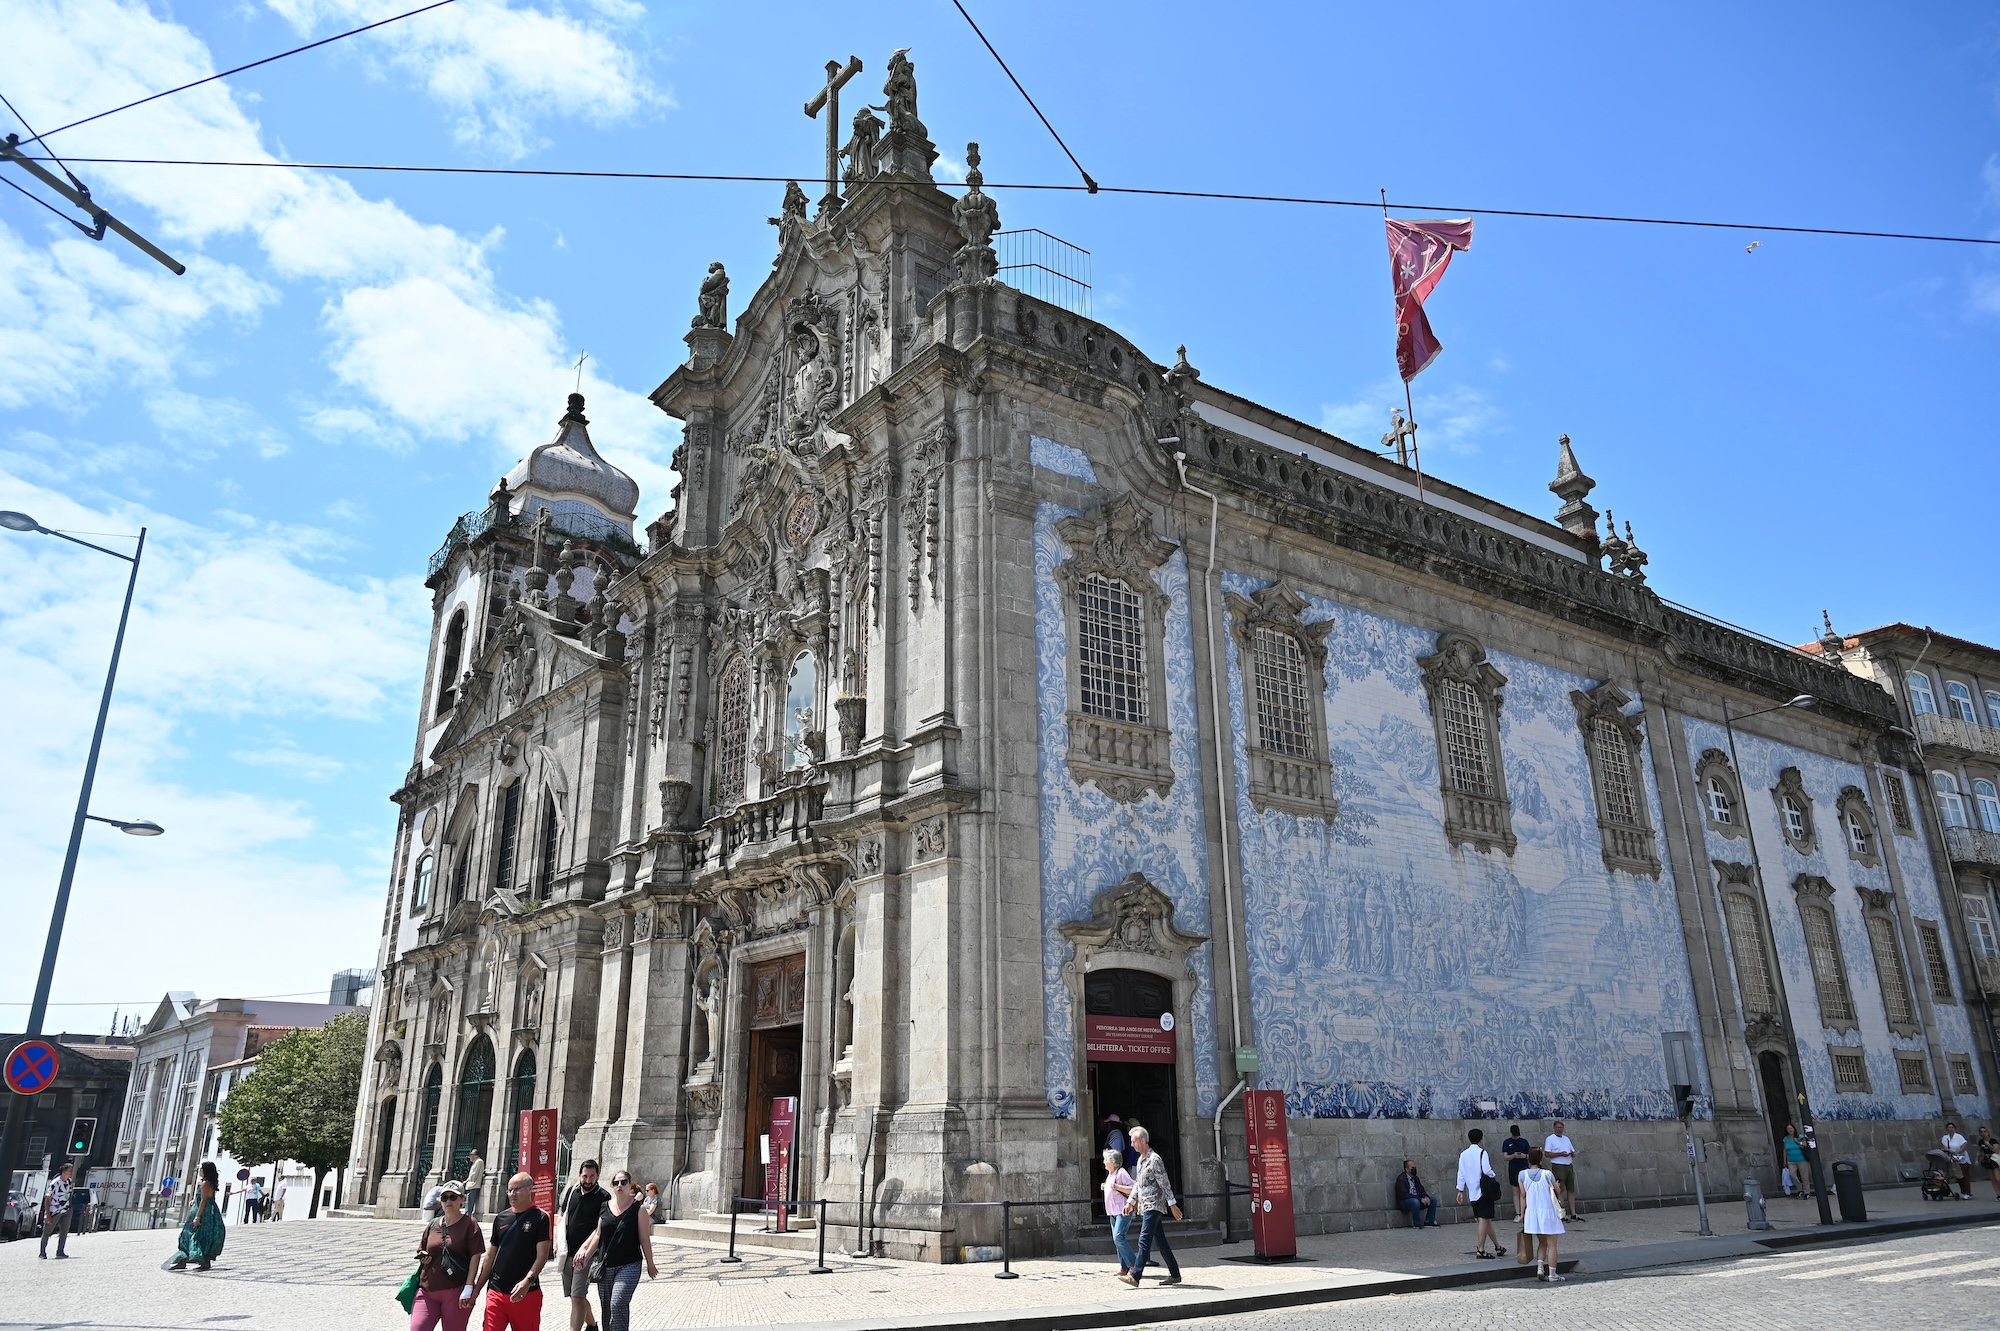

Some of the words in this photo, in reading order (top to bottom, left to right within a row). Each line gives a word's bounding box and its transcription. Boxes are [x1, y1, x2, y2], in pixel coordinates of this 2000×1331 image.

[1087, 1043, 1123, 1051] BILHETEIRA
[1128, 1045, 1149, 1053] TICKET
[1150, 1046, 1170, 1054] OFFICE
